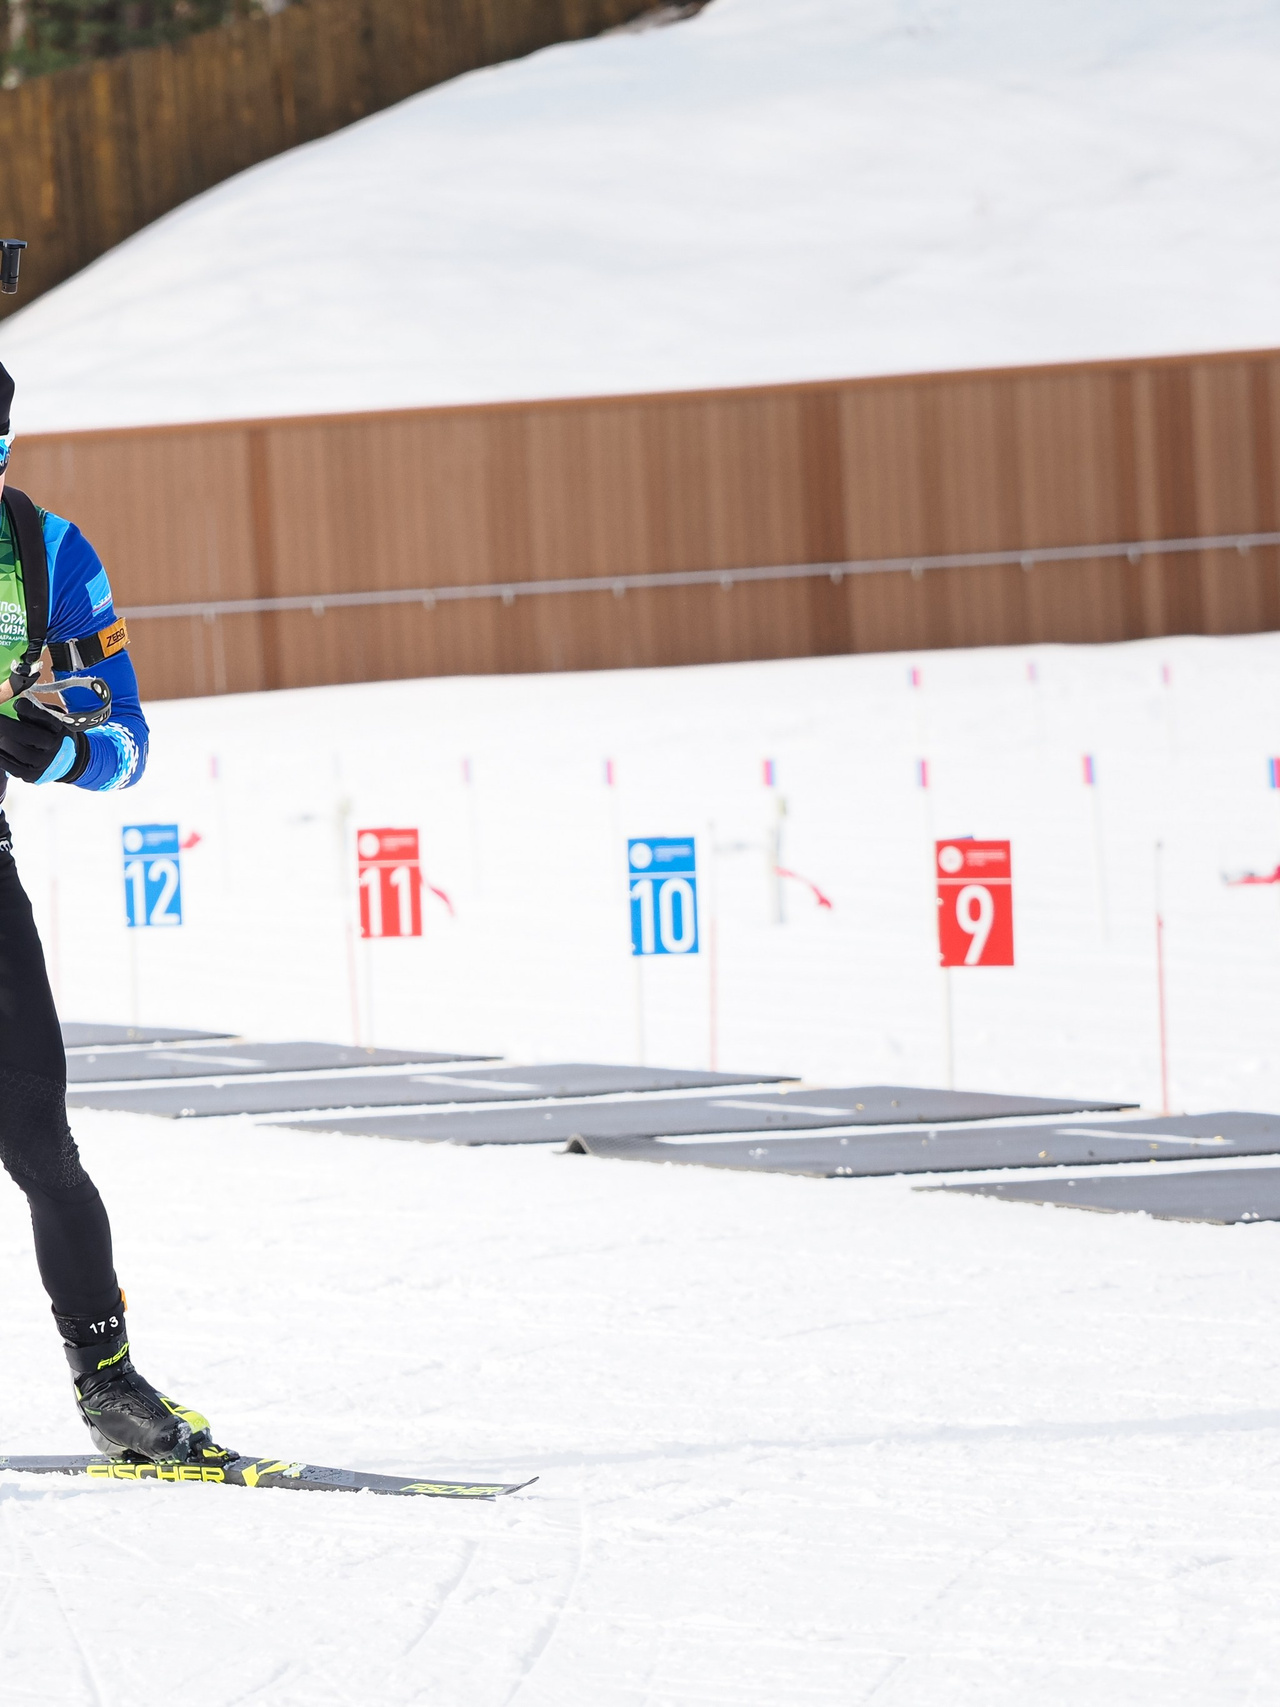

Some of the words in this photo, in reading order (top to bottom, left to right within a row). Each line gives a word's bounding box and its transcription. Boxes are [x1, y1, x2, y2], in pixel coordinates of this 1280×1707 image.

[106, 627, 126, 648] ZERO
[125, 859, 181, 926] 12
[360, 865, 413, 937] 11
[631, 877, 696, 954] 10
[955, 883, 995, 966] 9
[86, 1464, 226, 1484] FISCHER
[400, 1482, 504, 1496] FISCHER
